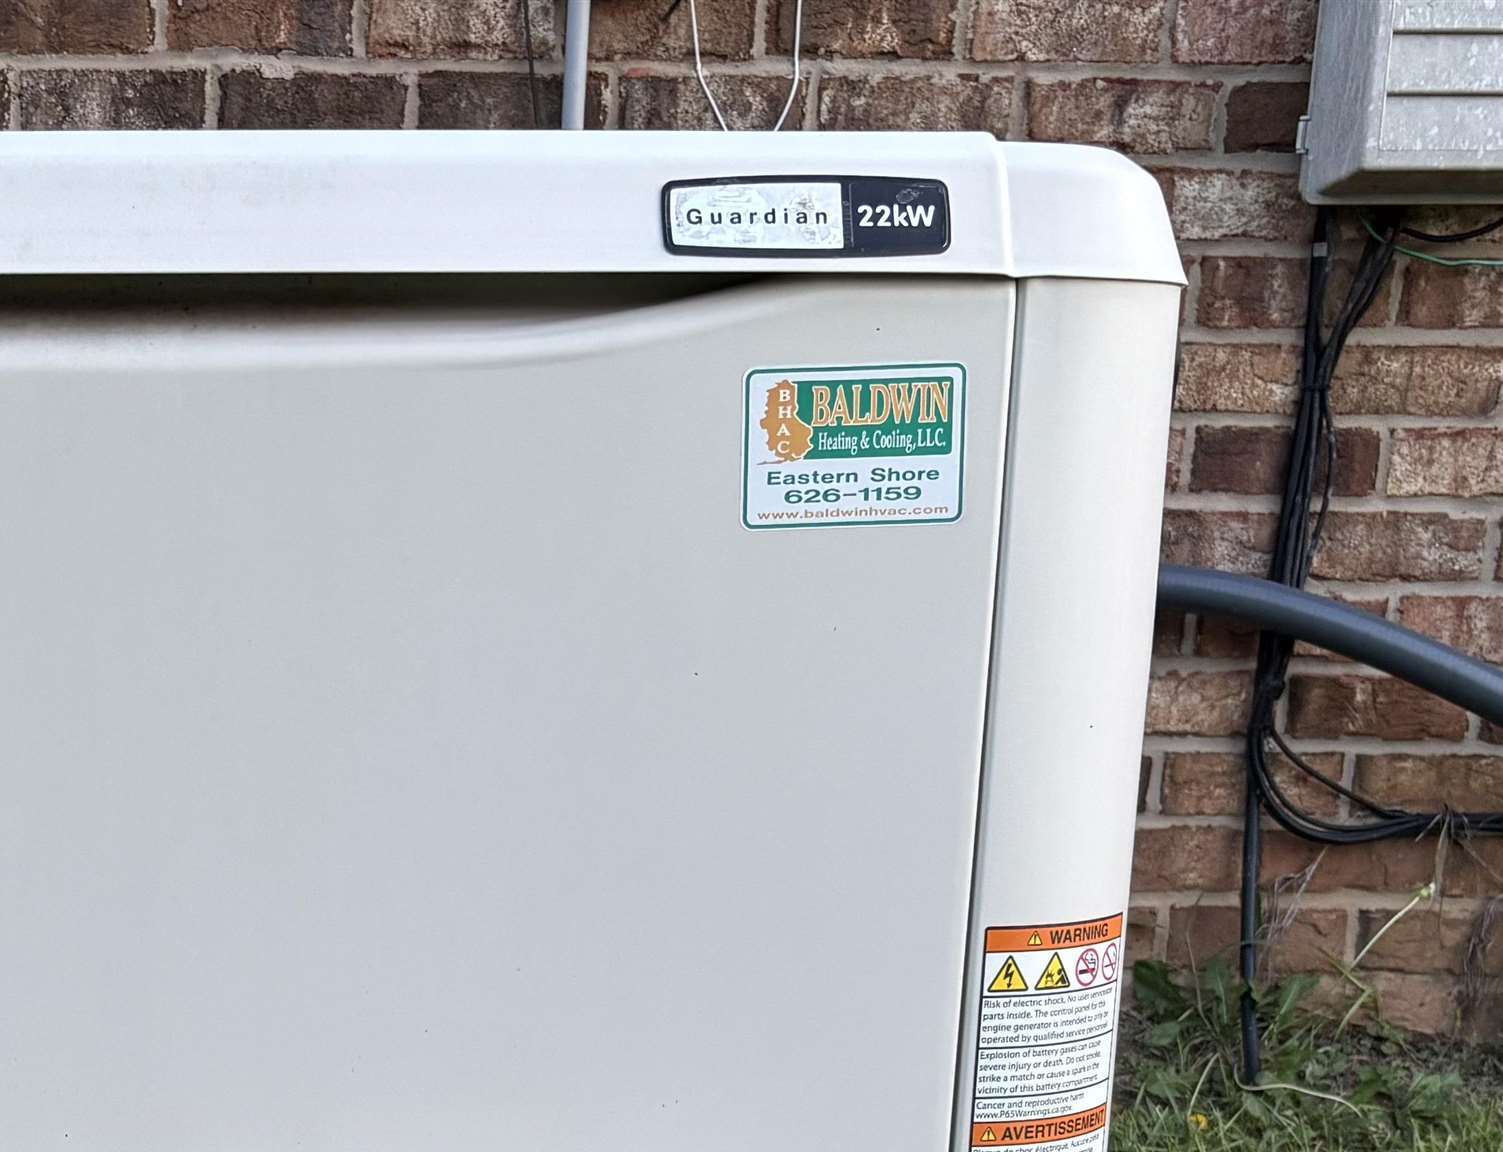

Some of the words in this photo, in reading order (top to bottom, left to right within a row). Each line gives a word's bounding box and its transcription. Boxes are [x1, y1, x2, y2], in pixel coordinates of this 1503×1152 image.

[686, 208, 828, 225] Guardian
[857, 204, 935, 228] 22kW
[811, 381, 951, 428] BALDWIN
[818, 431, 859, 455] Heating
[860, 431, 870, 450] &
[767, 471, 859, 485] Eastern
[871, 467, 940, 483] Shore
[784, 486, 922, 504] 626-1159
[757, 504, 949, 521] www.baldwinhvac.com
[1050, 923, 1109, 944] WARNING
[984, 1000, 1001, 1008] Risk
[1003, 1000, 1012, 1008] of
[983, 1012, 1004, 1020] parts
[1050, 1008, 1074, 1016] control
[982, 1024, 1011, 1033] engine
[1013, 1022, 1051, 1032] generator
[1060, 1017, 1087, 1026] intended
[981, 1035, 1019, 1044] operated
[1021, 1034, 1031, 1043] by
[1033, 1030, 1064, 1041] qualified
[980, 1051, 1020, 1060] Explosion
[1032, 1048, 1058, 1057] battery
[979, 1063, 1006, 1071] severe
[1008, 1062, 1031, 1071] injury
[978, 1074, 1001, 1082] strike
[1010, 1073, 1035, 1081] match
[1046, 1070, 1065, 1078] cause
[978, 1086, 1008, 1095] vicinity
[1036, 1080, 1061, 1091] battery
[976, 1101, 1005, 1109] Cancer
[1007, 1100, 1022, 1108] and
[1024, 1096, 1069, 1108] reproductive
[1001, 1109, 1104, 1140] AVERTISSEMENT
